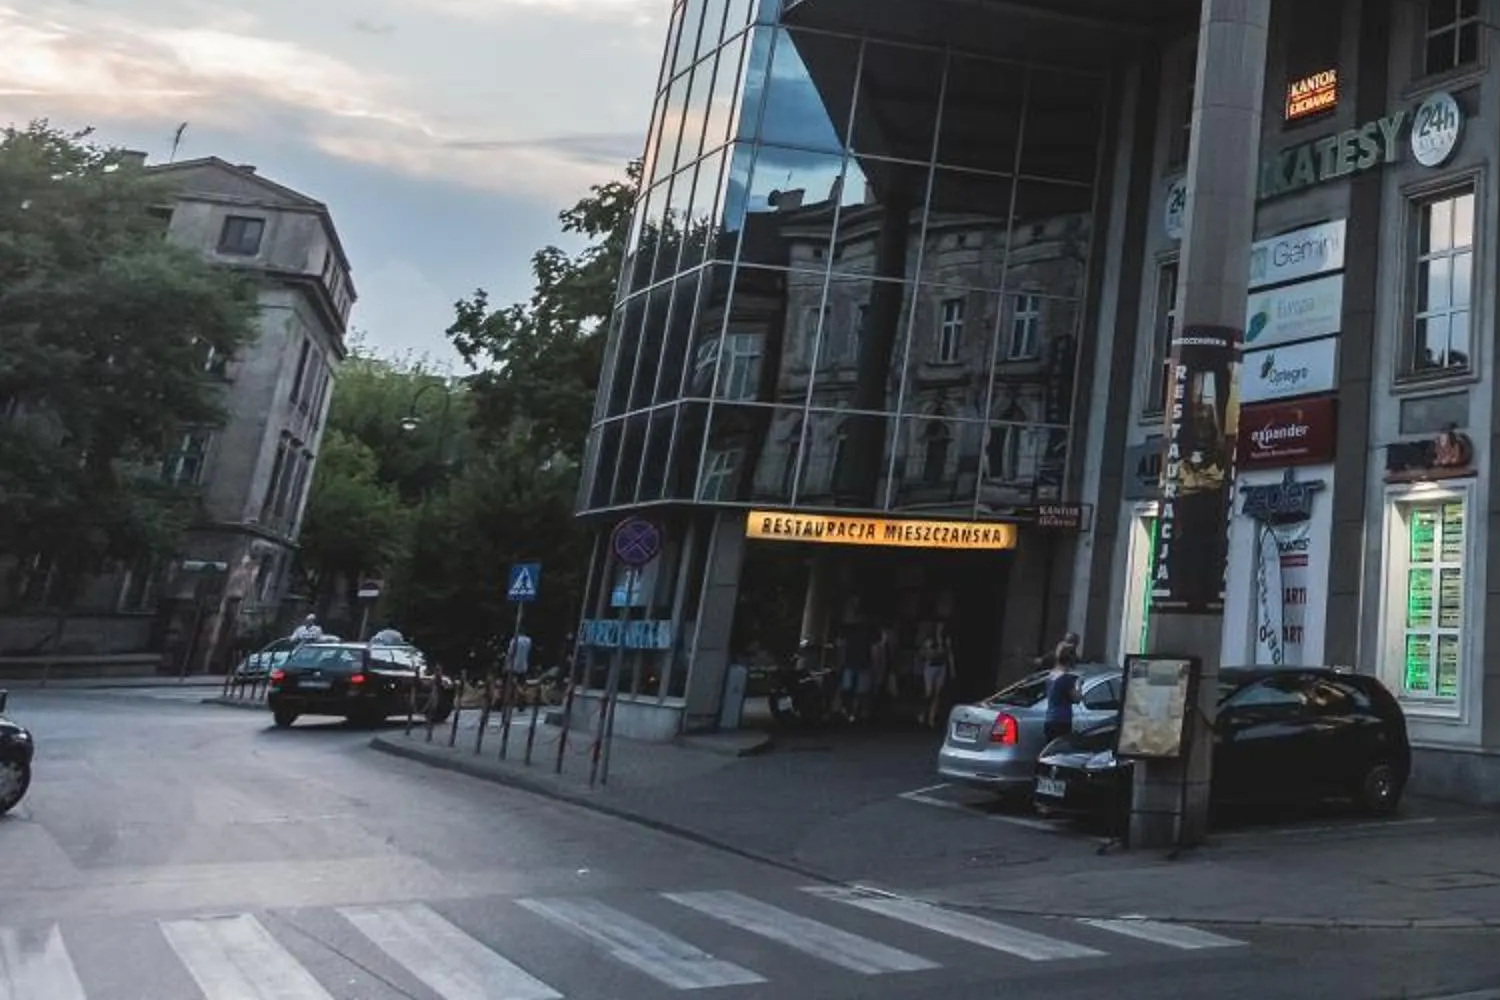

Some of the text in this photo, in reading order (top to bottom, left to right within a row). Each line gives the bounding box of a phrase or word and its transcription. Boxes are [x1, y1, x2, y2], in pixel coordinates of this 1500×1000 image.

[1291, 69, 1337, 97] KANTOR
[1289, 89, 1337, 115] EXCHANGE
[1251, 422, 1309, 445] expander
[1157, 365, 1188, 580] RESTAURACJA
[761, 516, 876, 540] RESTAURACJA
